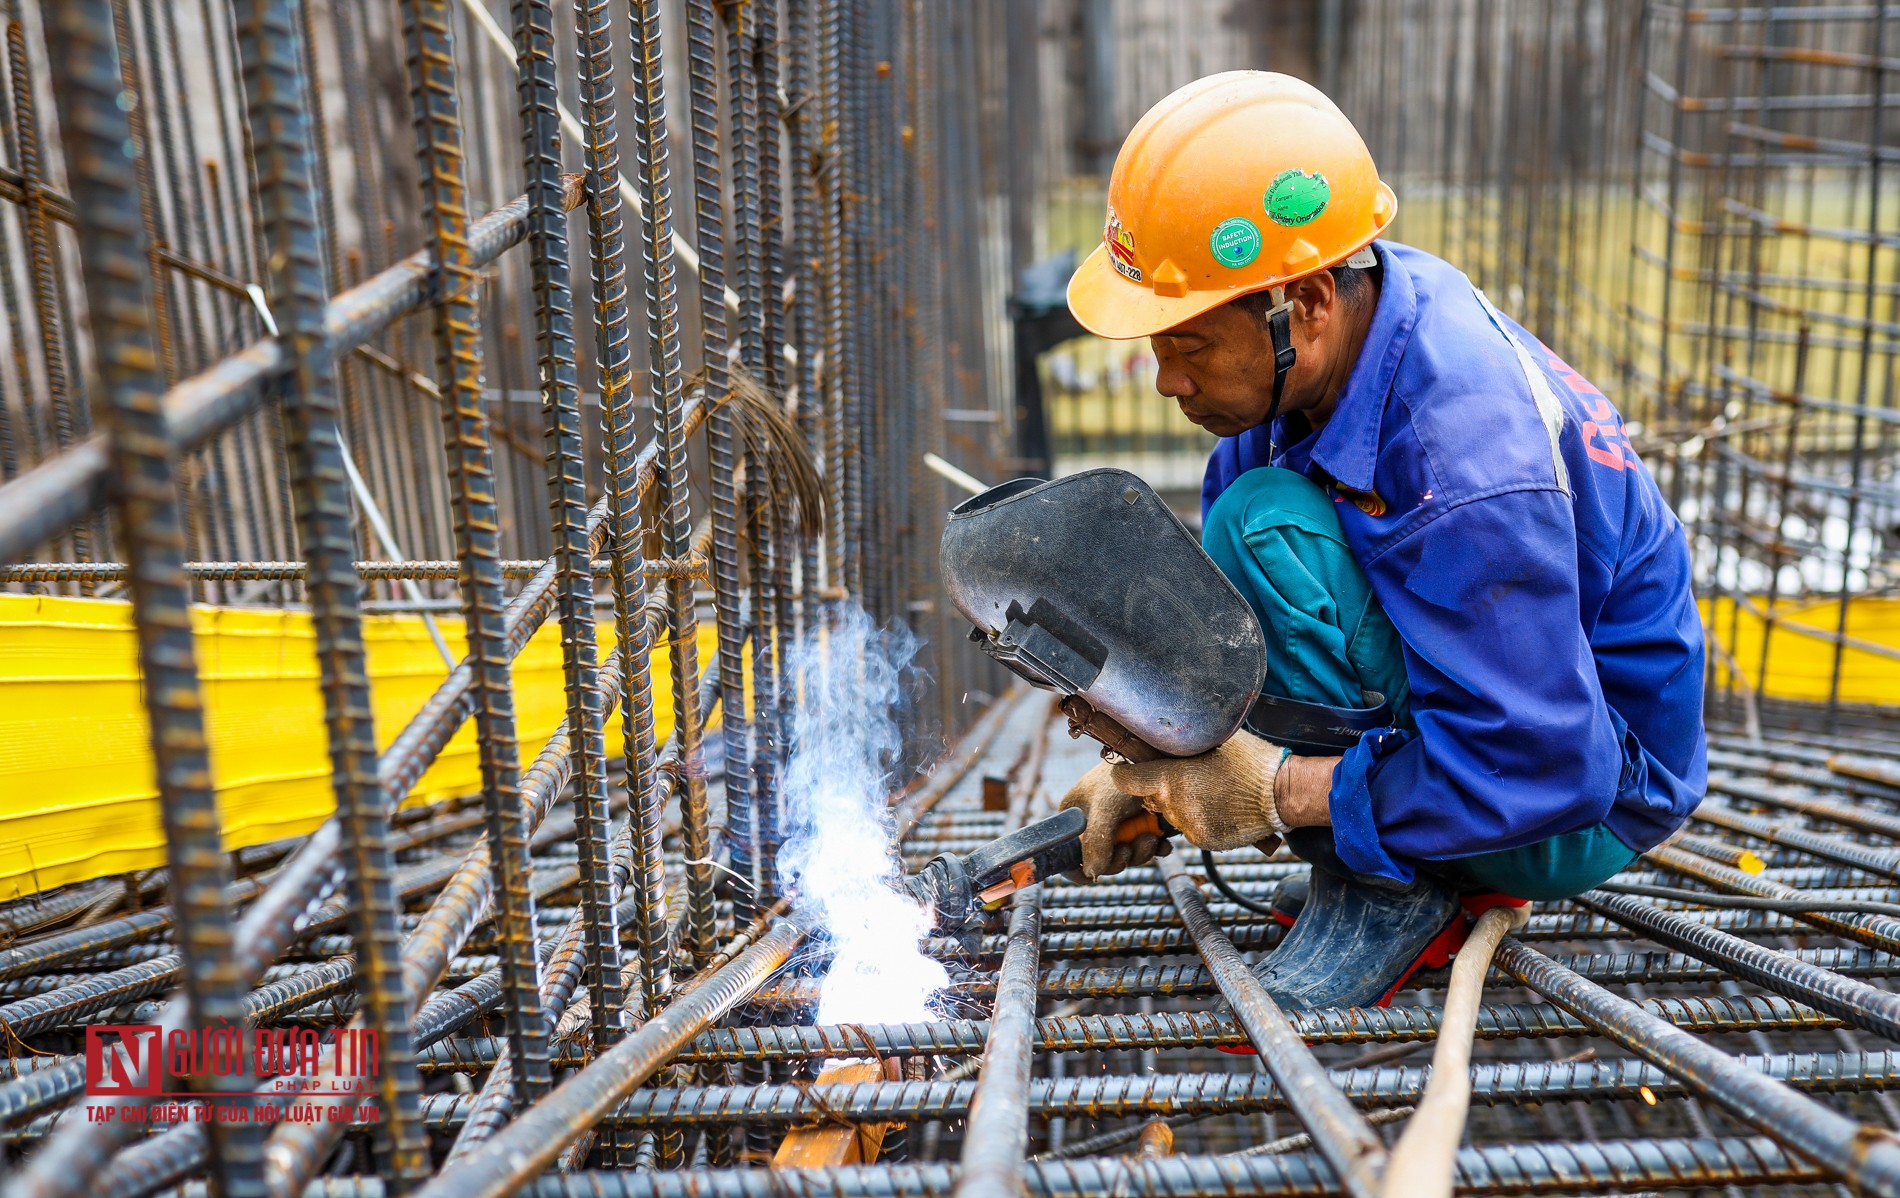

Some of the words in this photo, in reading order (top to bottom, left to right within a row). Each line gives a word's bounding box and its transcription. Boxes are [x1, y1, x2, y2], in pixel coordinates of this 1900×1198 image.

[1276, 213, 1295, 225] Safety
[1296, 202, 1325, 223] Orientation
[1219, 235, 1252, 250] INDUCTION
[1222, 229, 1244, 241] SAFETY
